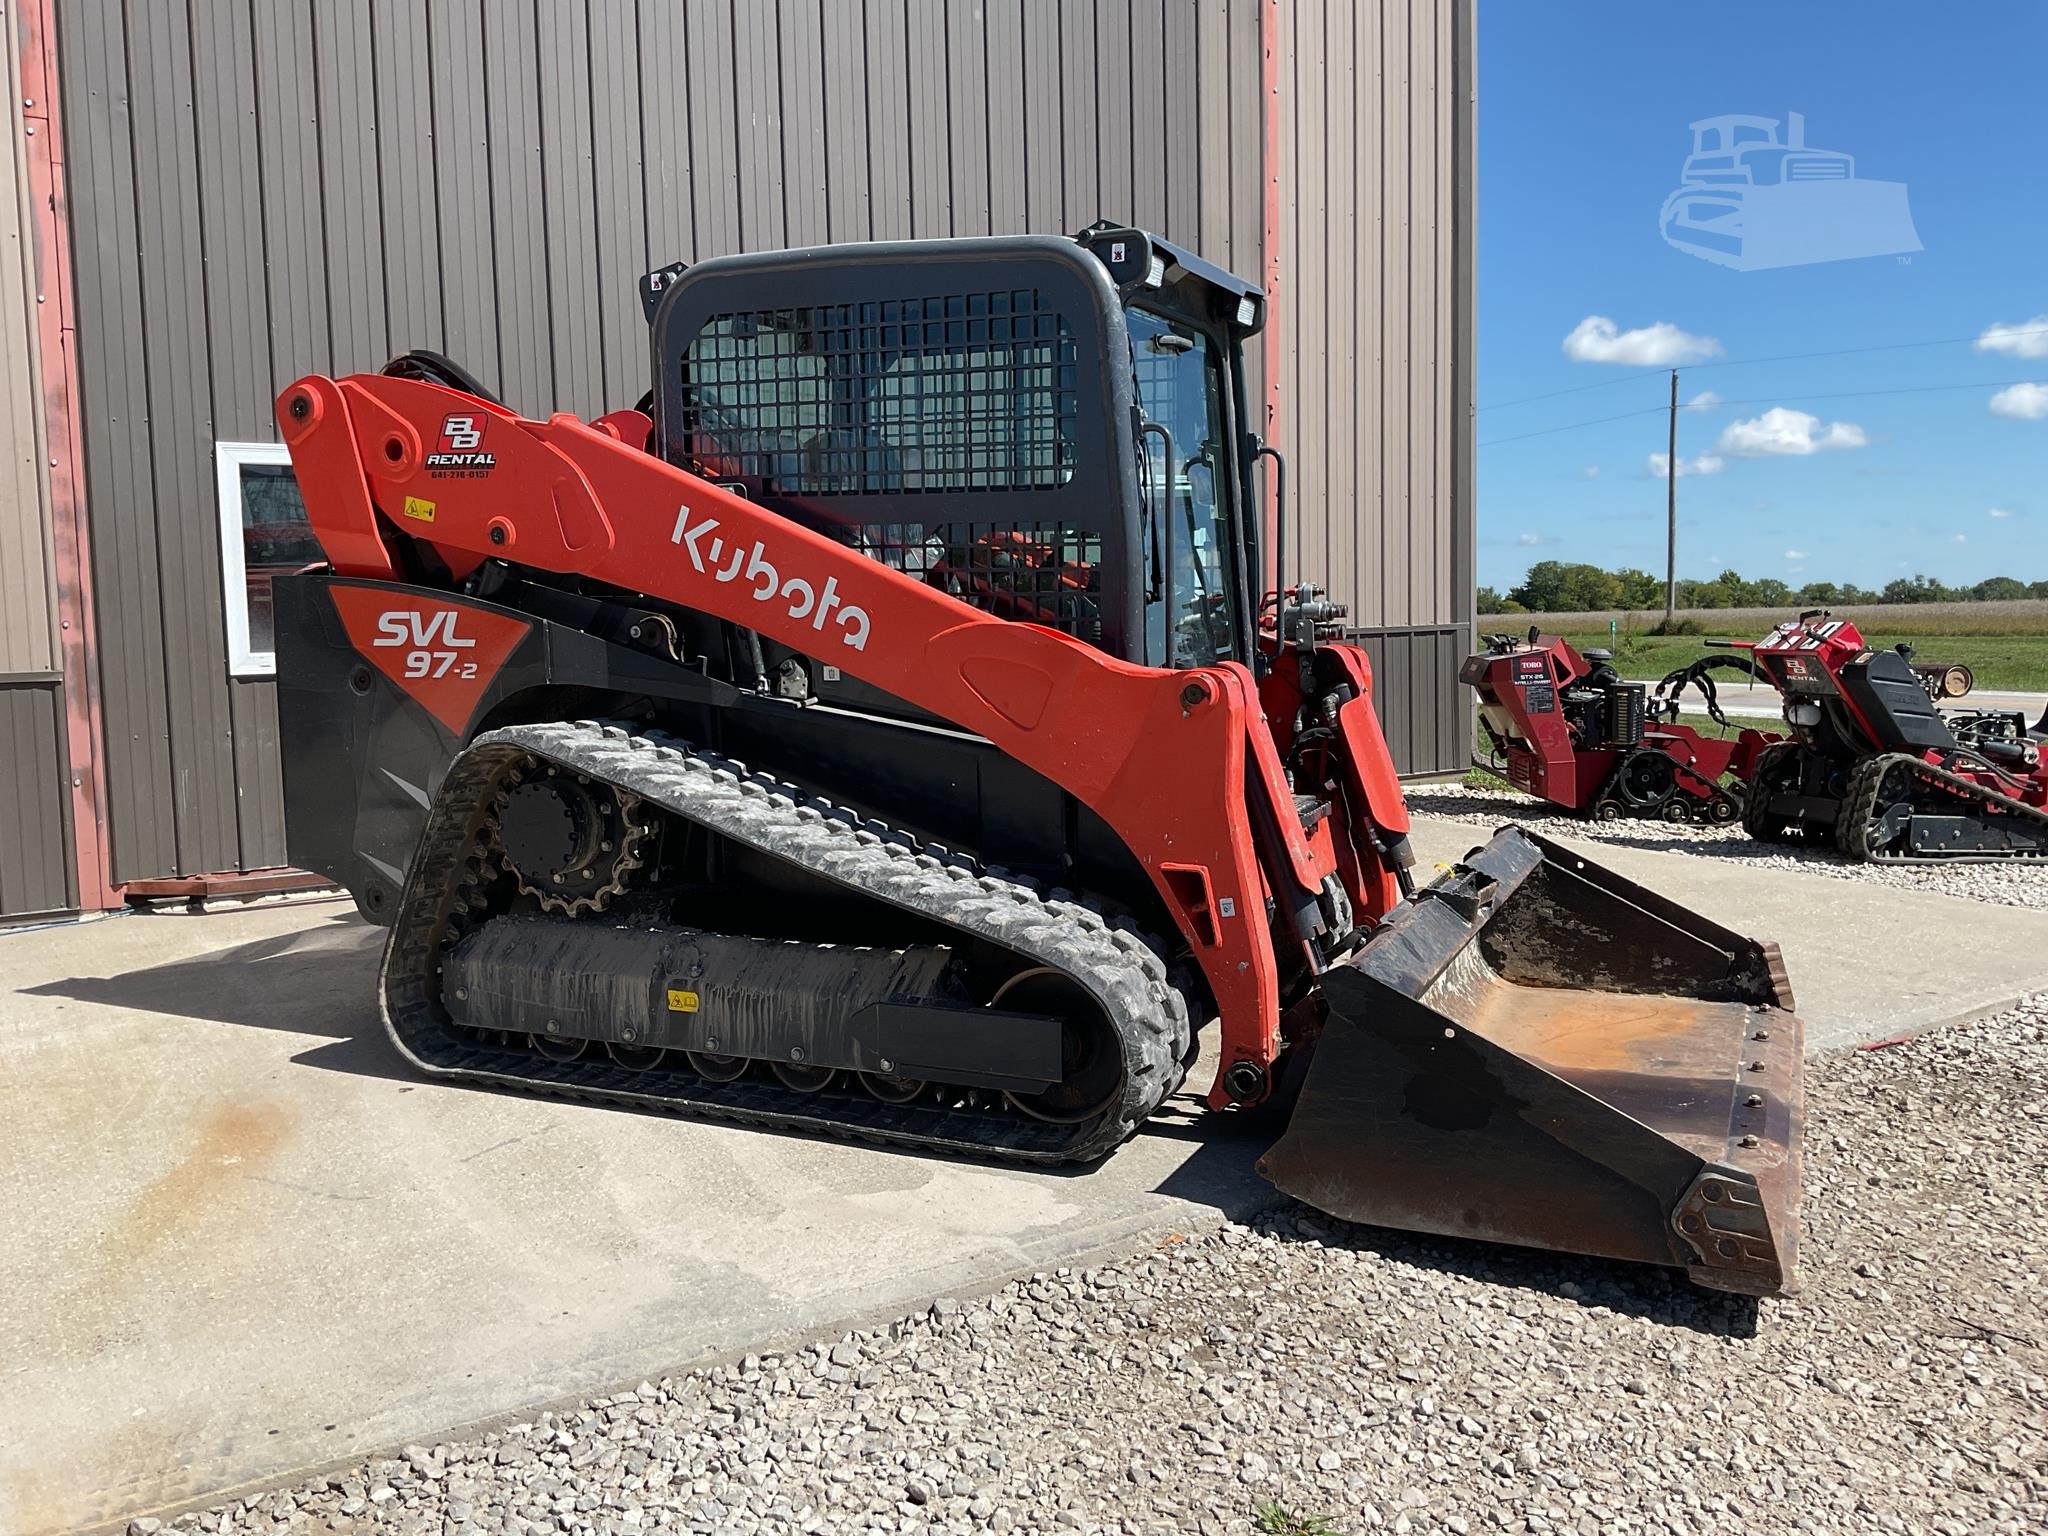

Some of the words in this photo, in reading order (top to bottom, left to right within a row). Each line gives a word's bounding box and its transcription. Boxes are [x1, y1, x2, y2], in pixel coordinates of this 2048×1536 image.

[427, 454, 496, 464] RENTAL
[671, 504, 871, 652] Kubota
[373, 611, 477, 647] SVL
[404, 651, 478, 679] 97-2
